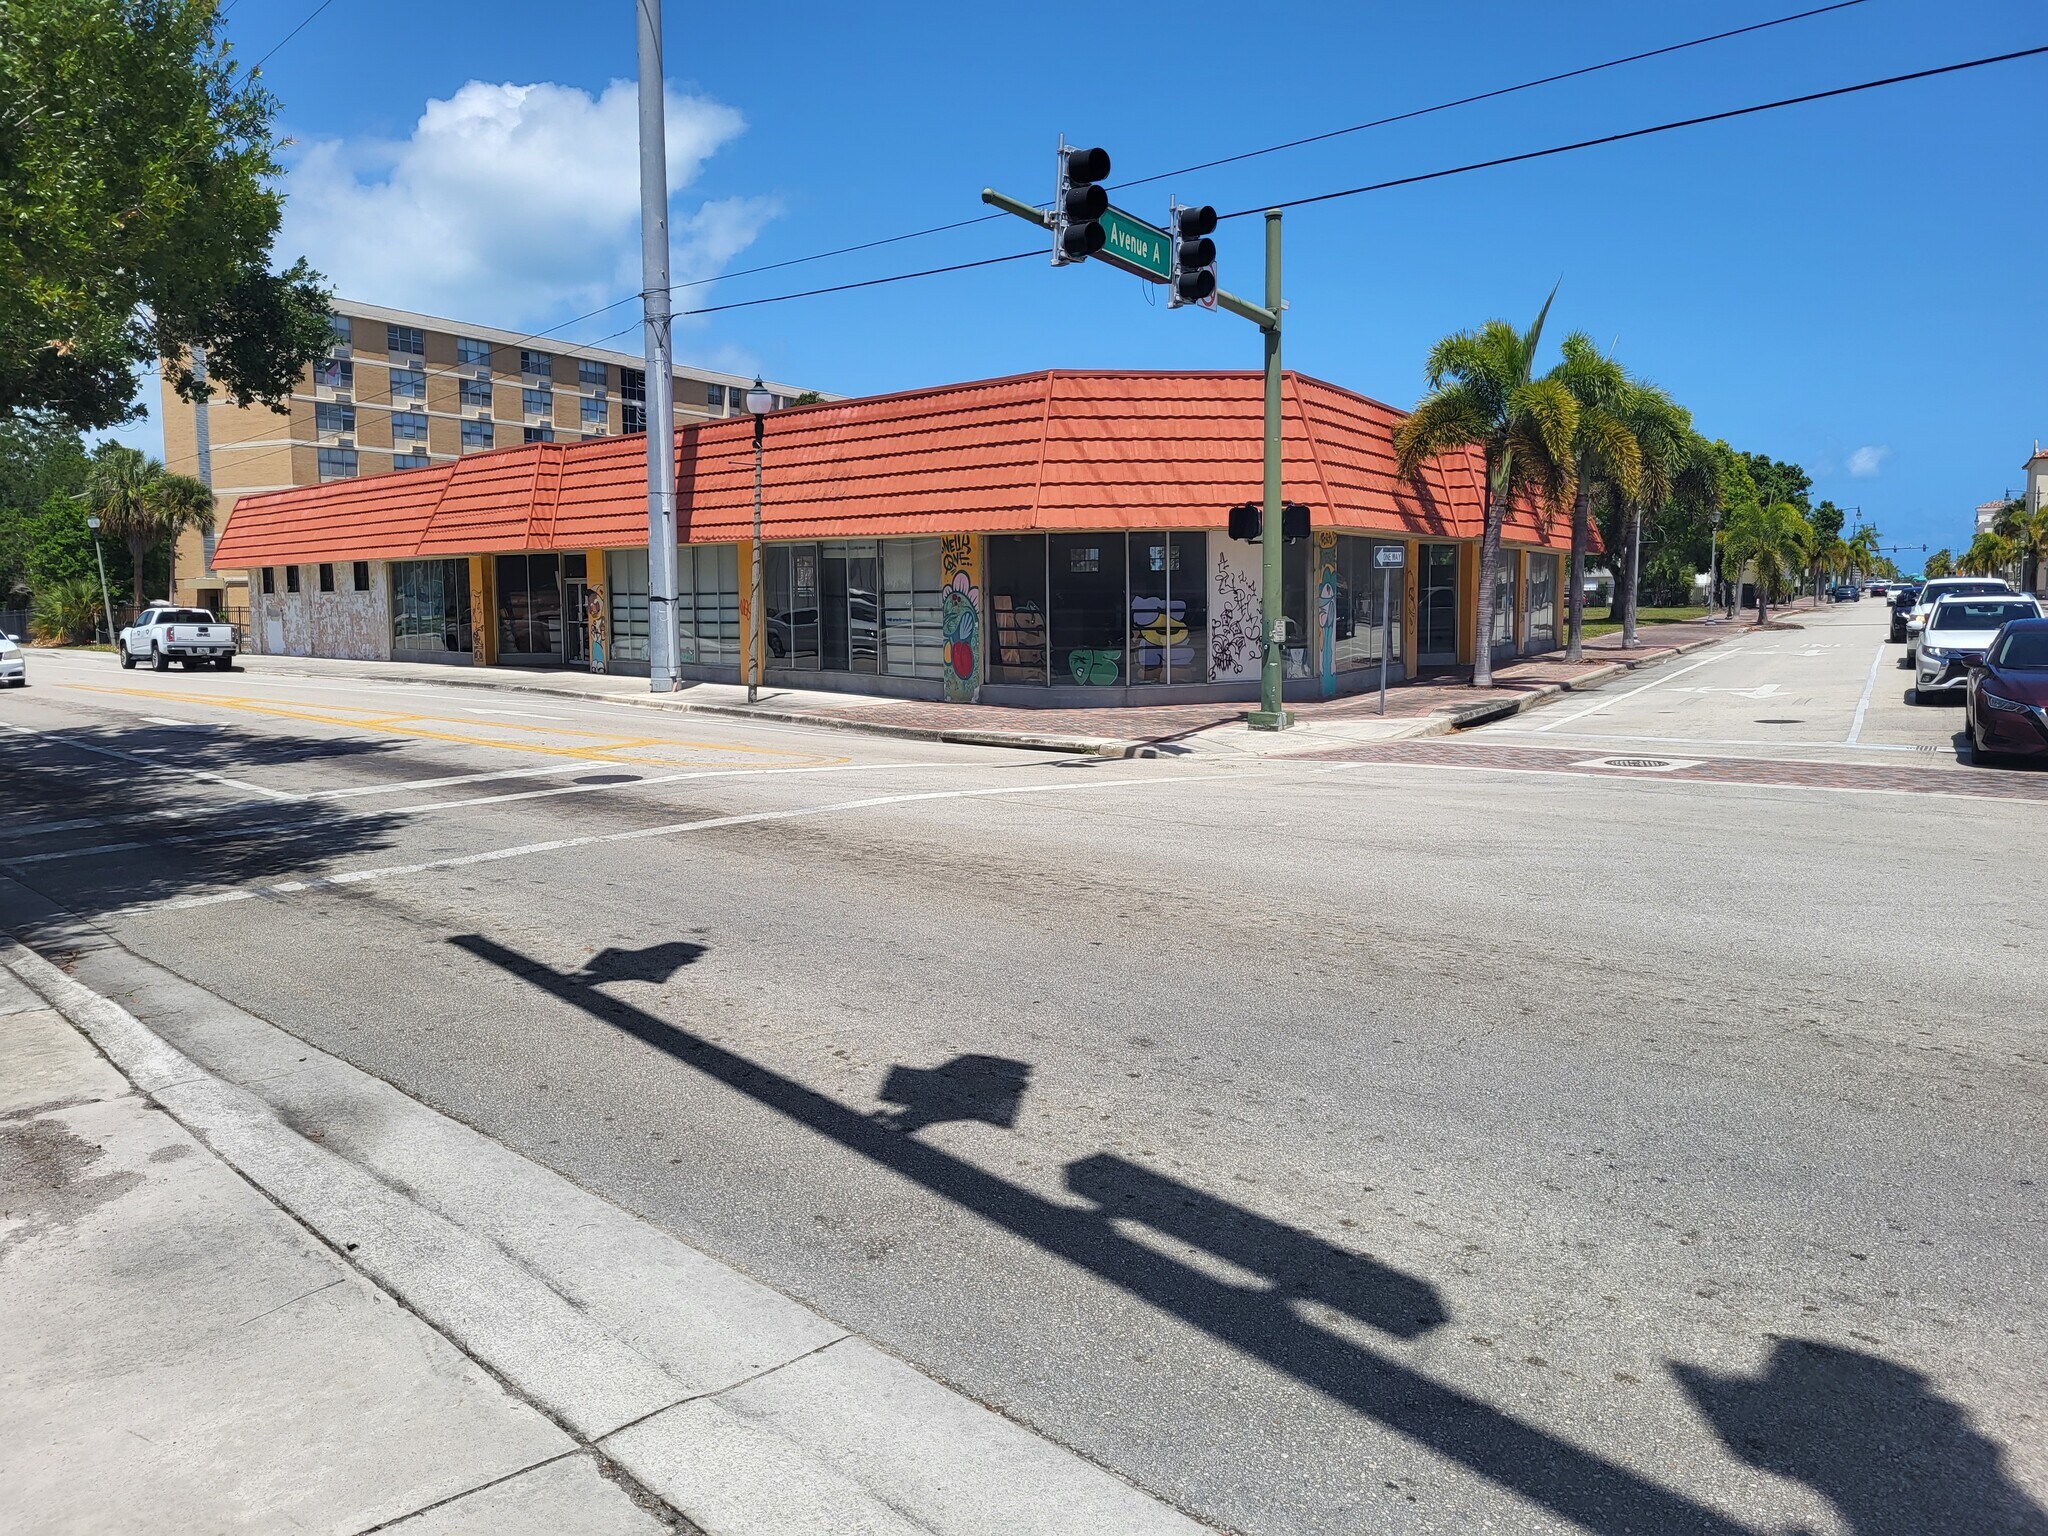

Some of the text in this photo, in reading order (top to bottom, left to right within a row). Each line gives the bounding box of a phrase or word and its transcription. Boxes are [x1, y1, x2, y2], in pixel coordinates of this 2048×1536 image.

[1110, 222, 1160, 264] Avenue A
[1383, 552, 1401, 561] ONE WAY
